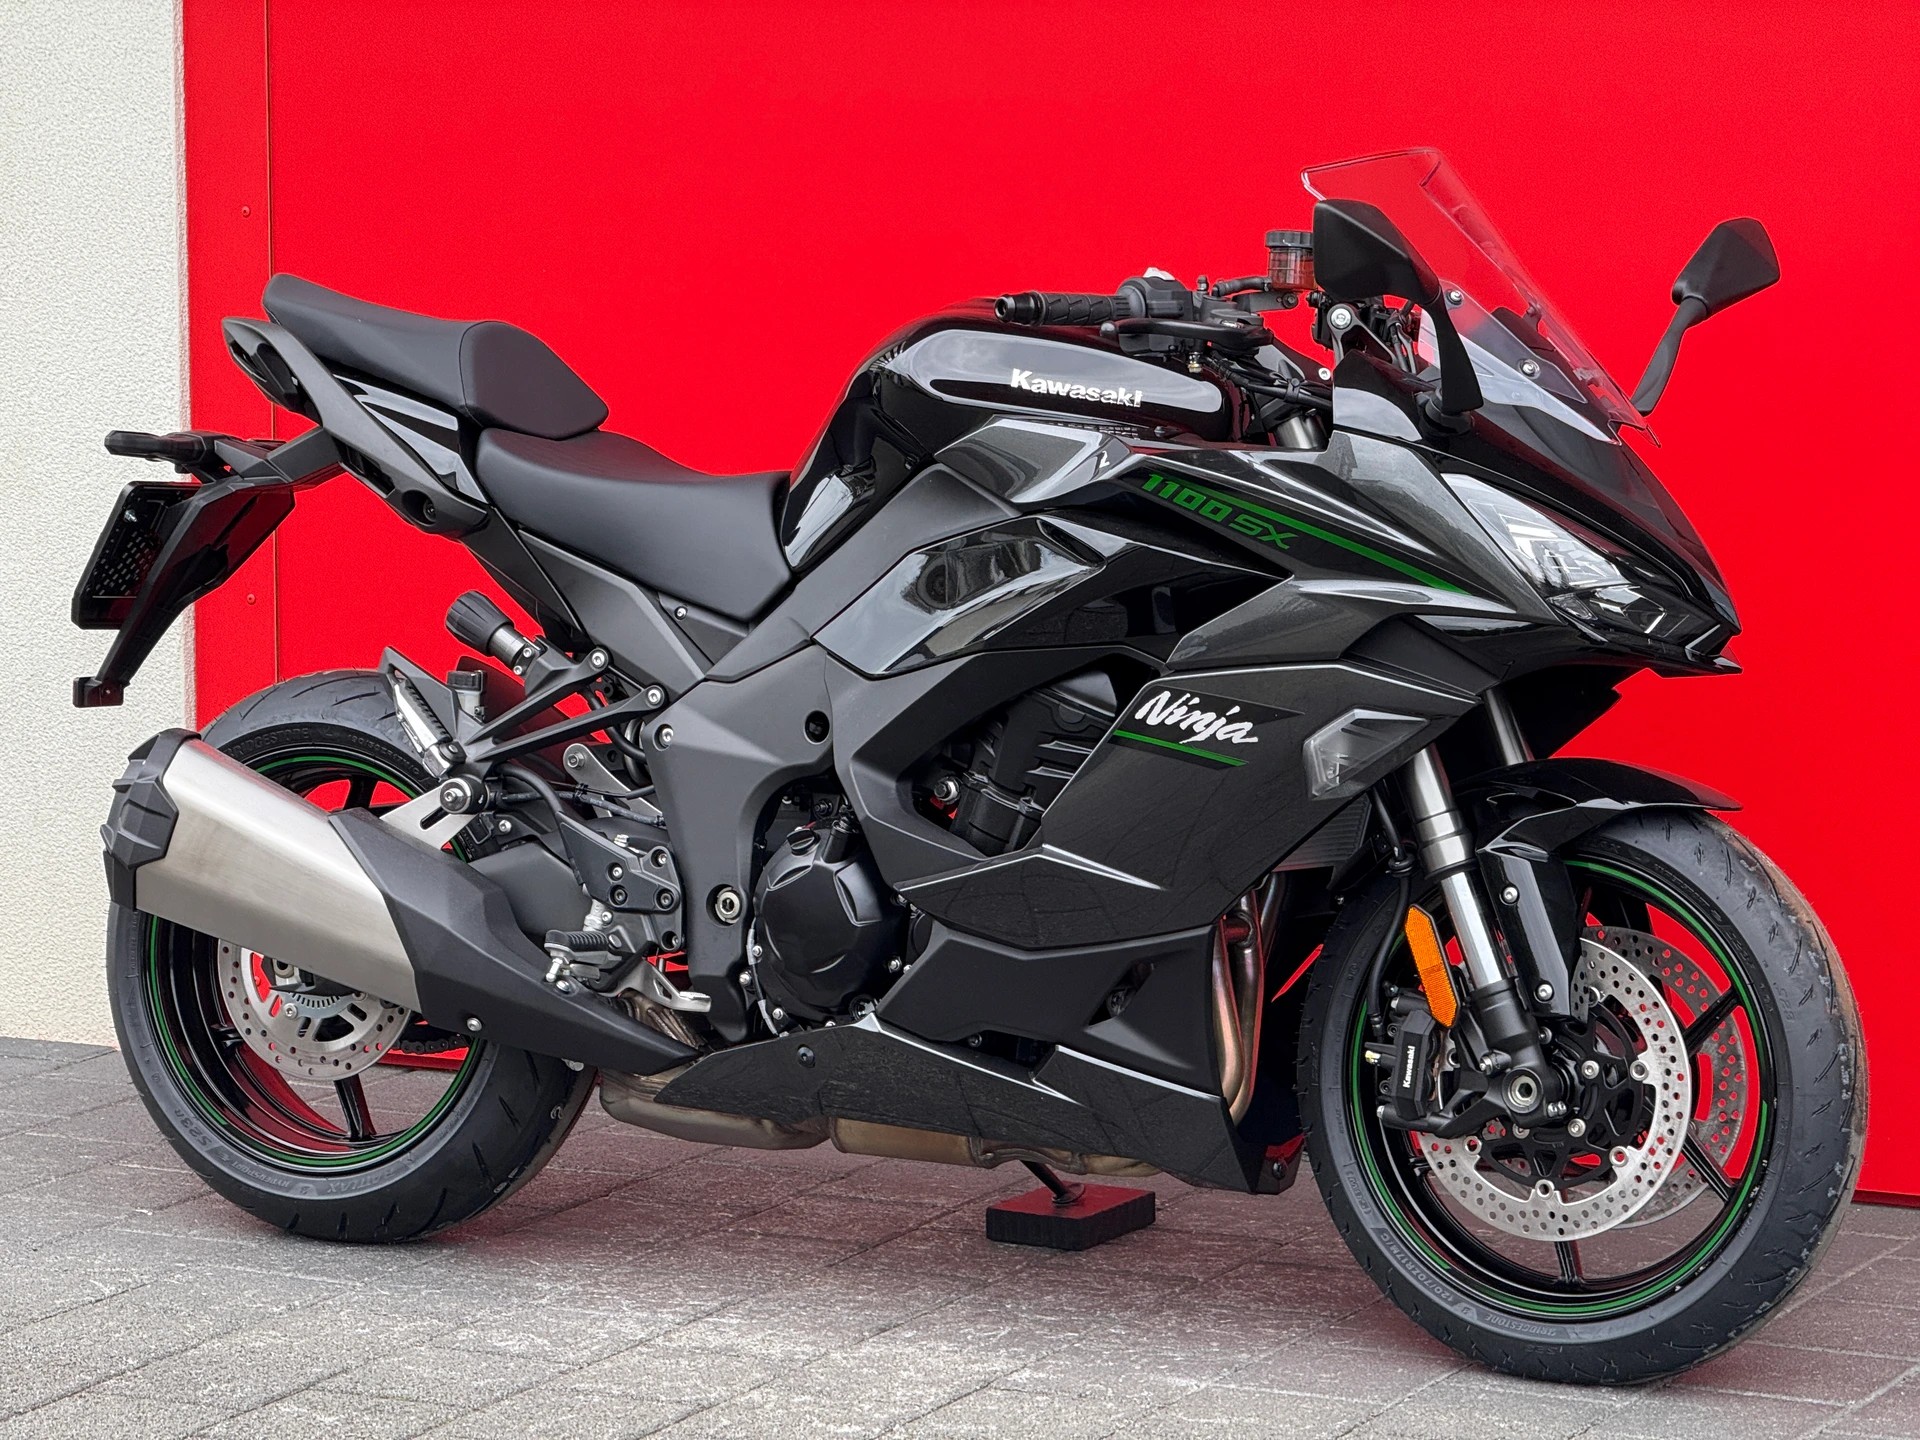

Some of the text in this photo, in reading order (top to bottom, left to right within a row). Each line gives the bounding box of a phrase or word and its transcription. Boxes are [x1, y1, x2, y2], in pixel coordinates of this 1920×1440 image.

[1010, 367, 1143, 408] Kawasaki
[1141, 473, 1299, 550] 1100 SX
[1134, 690, 1259, 744] Ninja
[1402, 1045, 1416, 1088] Kawasaki
[1485, 1313, 1556, 1336] BRIDGESTONE
